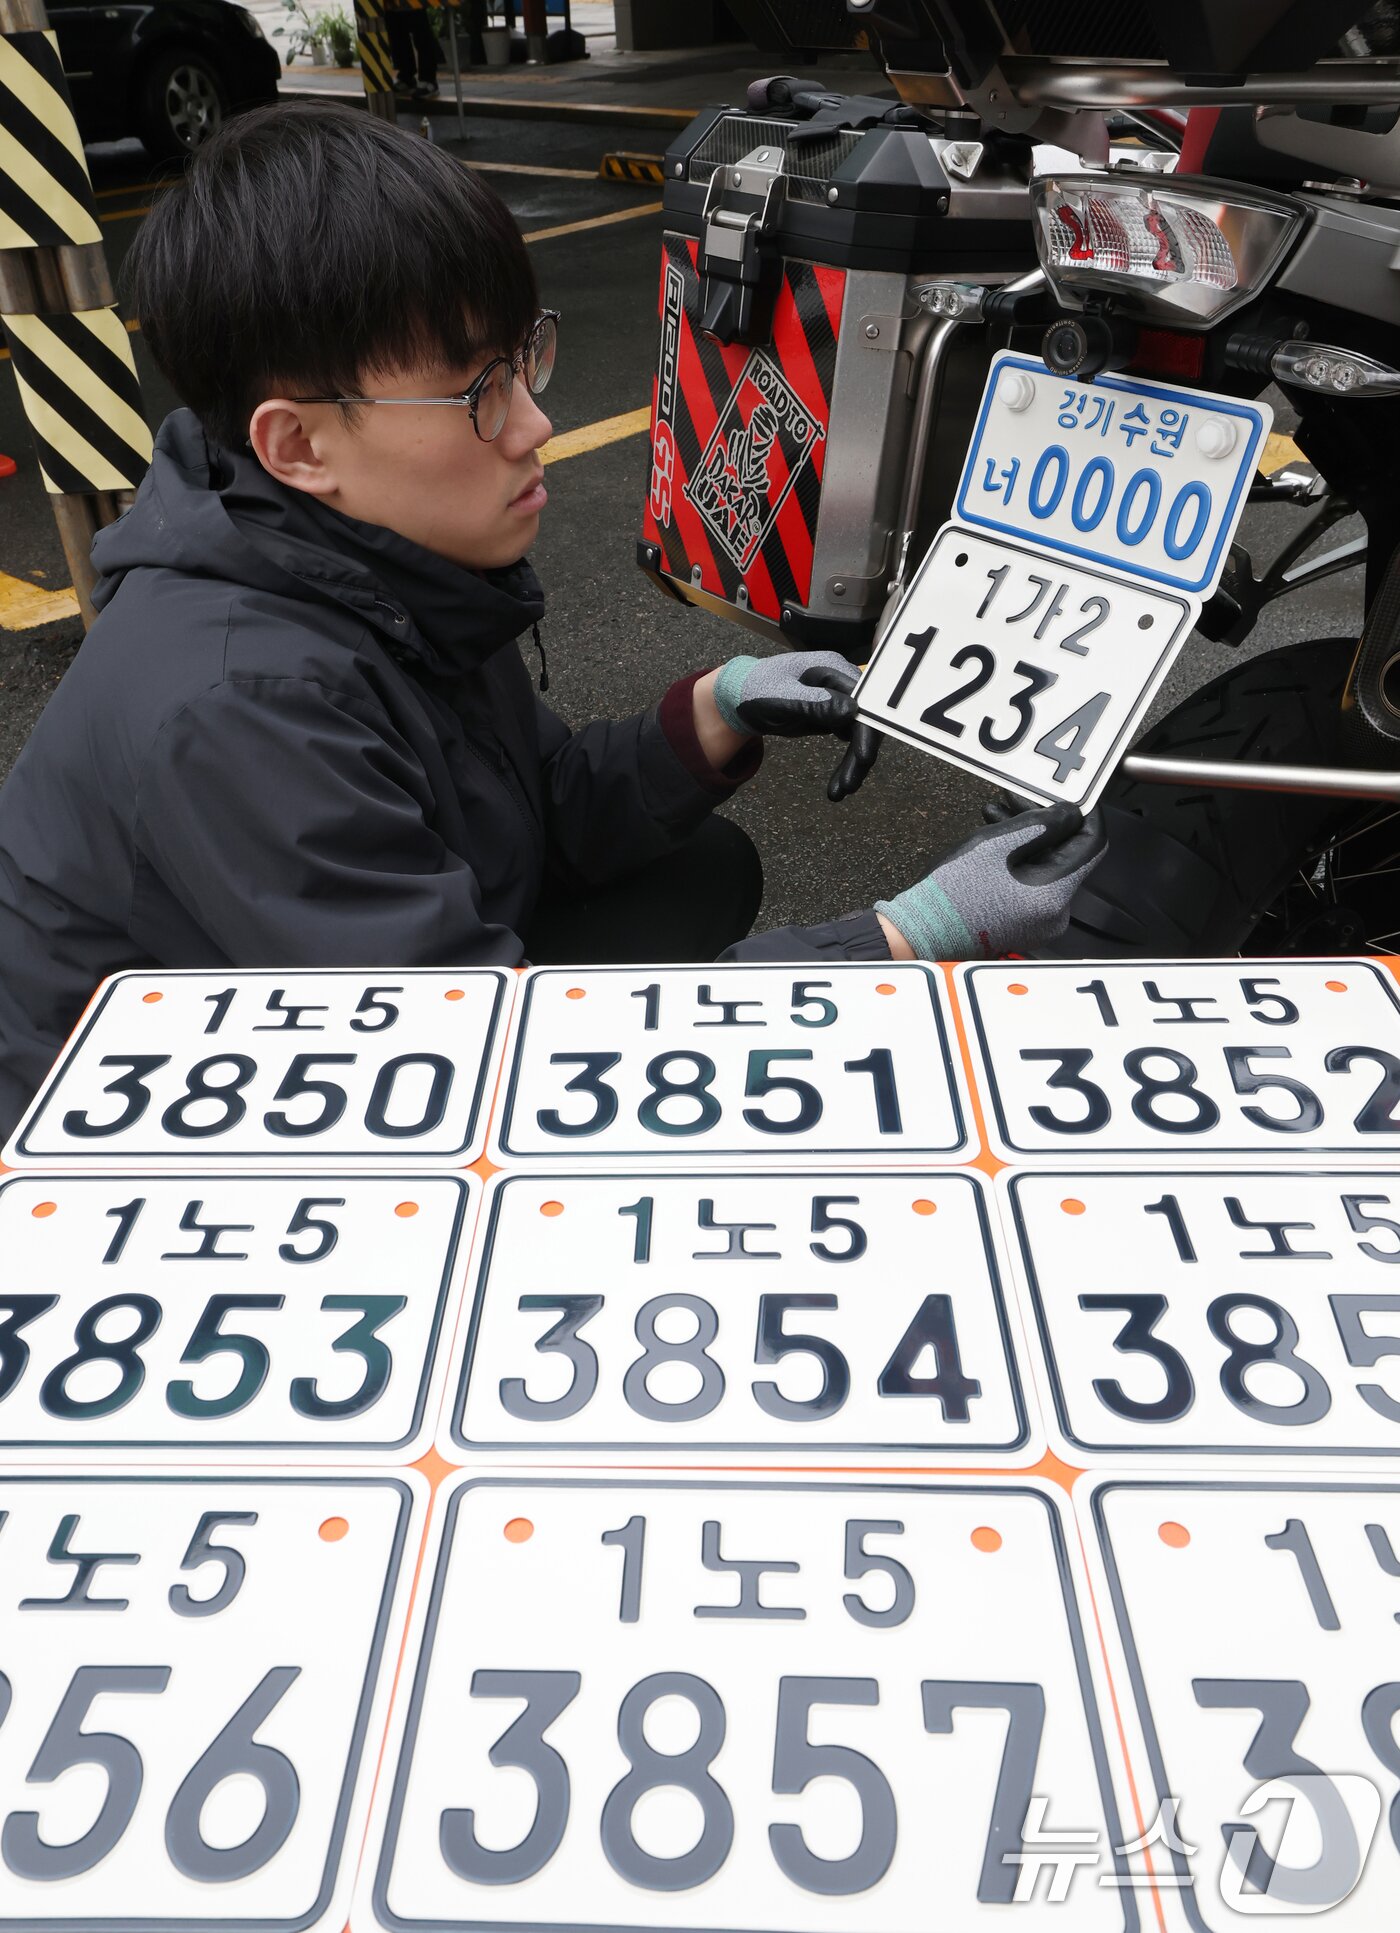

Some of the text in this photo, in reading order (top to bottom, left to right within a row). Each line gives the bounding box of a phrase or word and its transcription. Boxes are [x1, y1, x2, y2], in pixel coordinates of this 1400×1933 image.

[748, 356, 810, 443] ROAD TO
[706, 445, 760, 537] DAKAR
[886, 625, 1112, 783] 1234
[62, 1052, 456, 1139] 3850
[536, 1048, 904, 1138] 3851
[1019, 1045, 1400, 1135] 3852
[499, 1292, 982, 1423] 3854
[439, 1668, 1047, 1904] 3857
